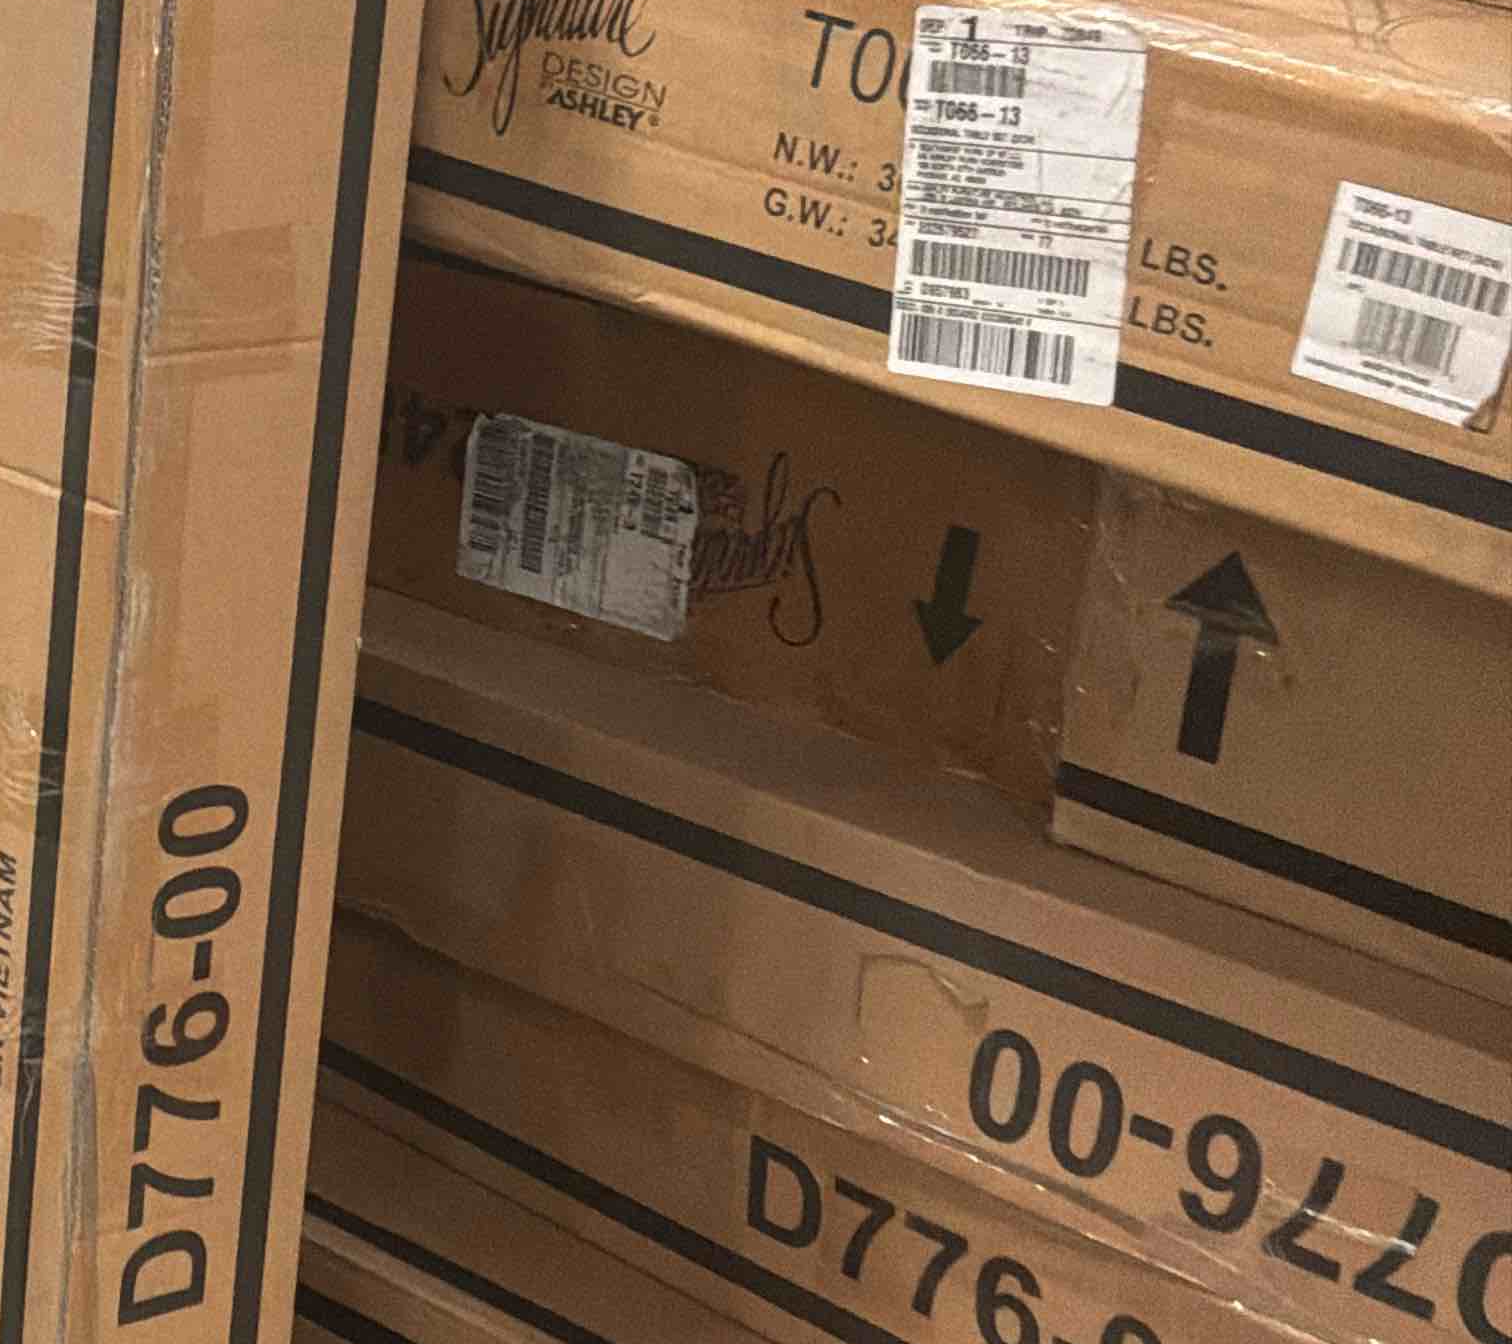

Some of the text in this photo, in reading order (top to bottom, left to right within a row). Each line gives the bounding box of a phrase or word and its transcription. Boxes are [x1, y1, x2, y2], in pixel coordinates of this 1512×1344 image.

[541, 50, 667, 109] DESIGN
[960, 15, 977, 41] 1
[546, 88, 646, 131] ASHLEY
[772, 131, 858, 182] N.W.:
[1140, 238, 1229, 292] LBS.
[762, 187, 849, 238] G.W.:
[1127, 296, 1215, 349] LBS.
[117, 784, 250, 1328] D776-00
